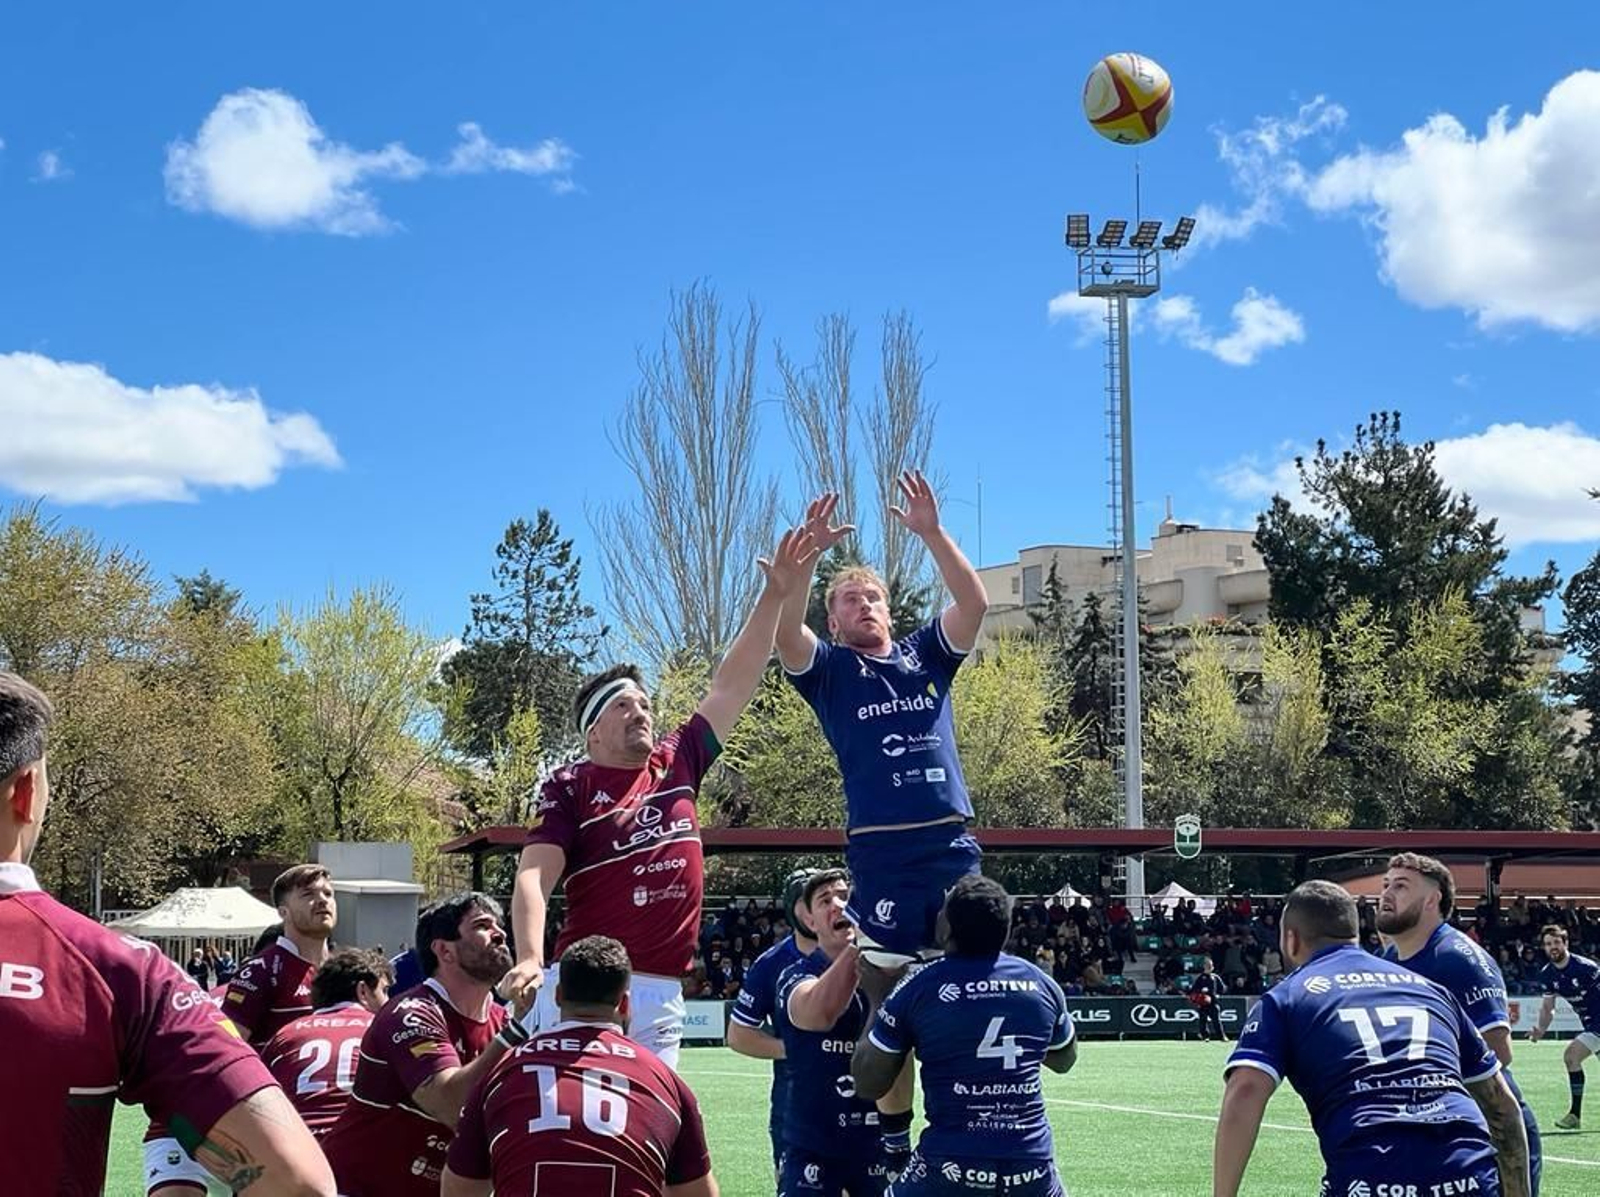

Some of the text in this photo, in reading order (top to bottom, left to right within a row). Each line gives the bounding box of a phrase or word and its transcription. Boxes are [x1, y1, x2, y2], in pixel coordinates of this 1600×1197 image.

[857, 694, 935, 720] enerside
[612, 818, 693, 850] LEXUS
[965, 980, 1040, 993] CORTEVA
[1334, 972, 1428, 987] CORTEVA
[296, 1018, 372, 1030] KREA
[1337, 1005, 1429, 1066] 17
[514, 1038, 637, 1059] KREAB
[976, 1016, 1024, 1070] 4
[522, 1064, 632, 1137] 16
